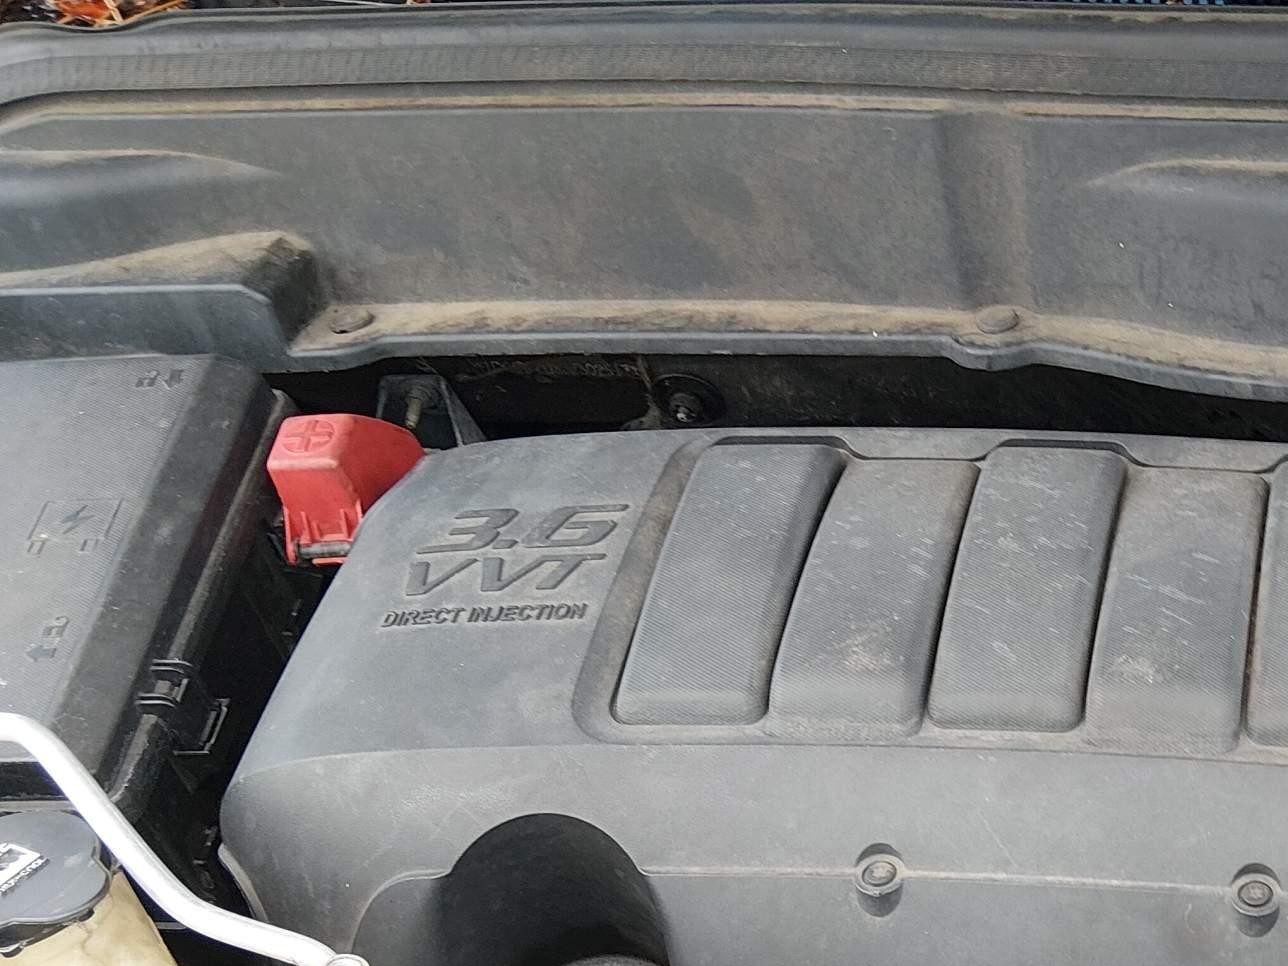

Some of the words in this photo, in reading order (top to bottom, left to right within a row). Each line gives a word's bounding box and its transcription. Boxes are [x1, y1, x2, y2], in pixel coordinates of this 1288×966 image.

[416, 504, 629, 554] 3.6
[406, 553, 607, 596] VVT
[380, 606, 465, 628] DIRECT
[467, 602, 589, 624] INJECTION
